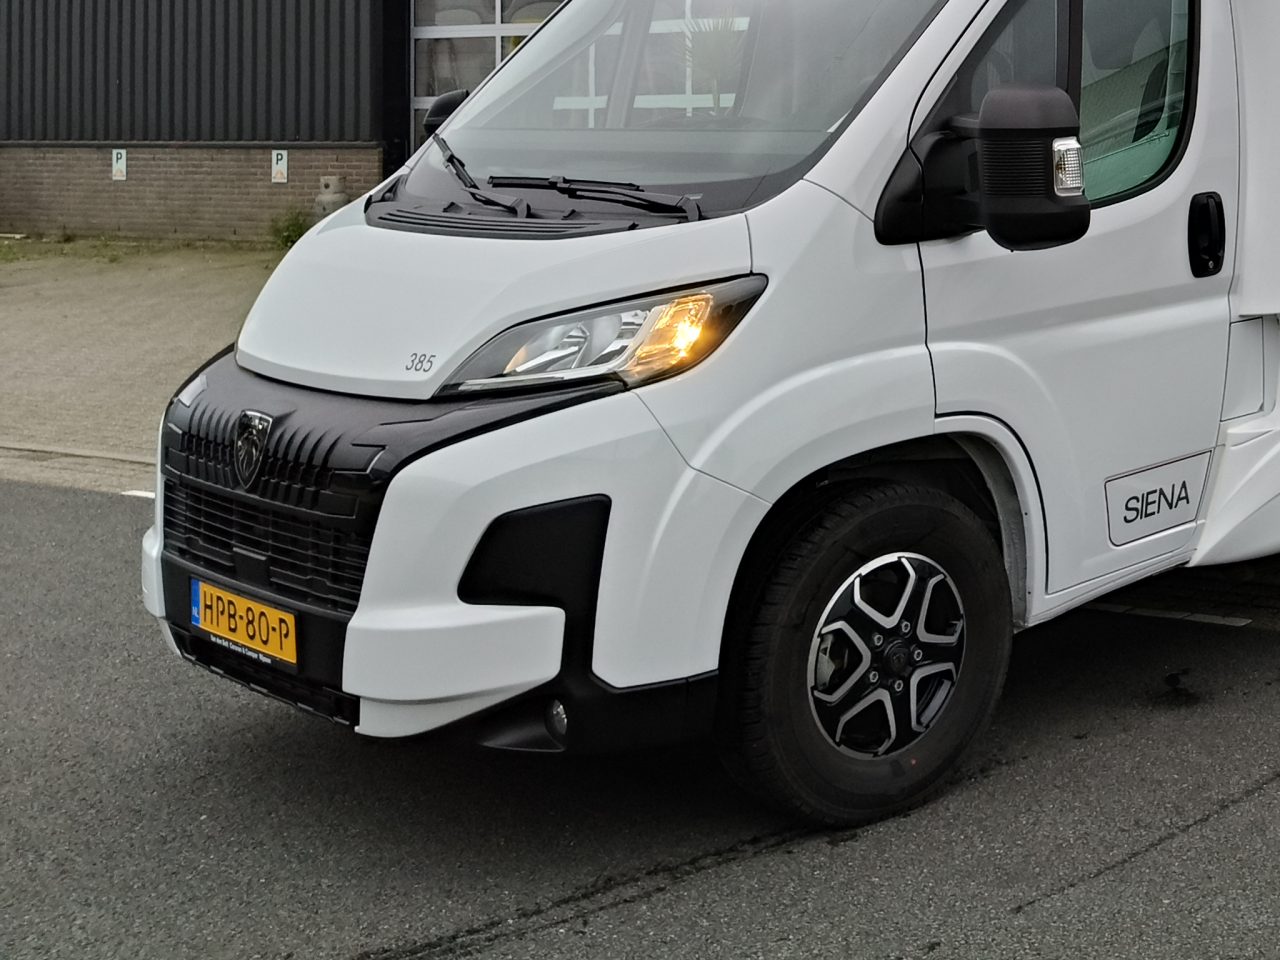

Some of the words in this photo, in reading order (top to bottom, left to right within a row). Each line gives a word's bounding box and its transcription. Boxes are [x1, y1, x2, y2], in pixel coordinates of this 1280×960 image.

[115, 152, 123, 165] P
[275, 152, 284, 166] P
[405, 352, 436, 373] 385
[1123, 480, 1190, 524] SIENA
[203, 590, 290, 651] HPB-80-P
